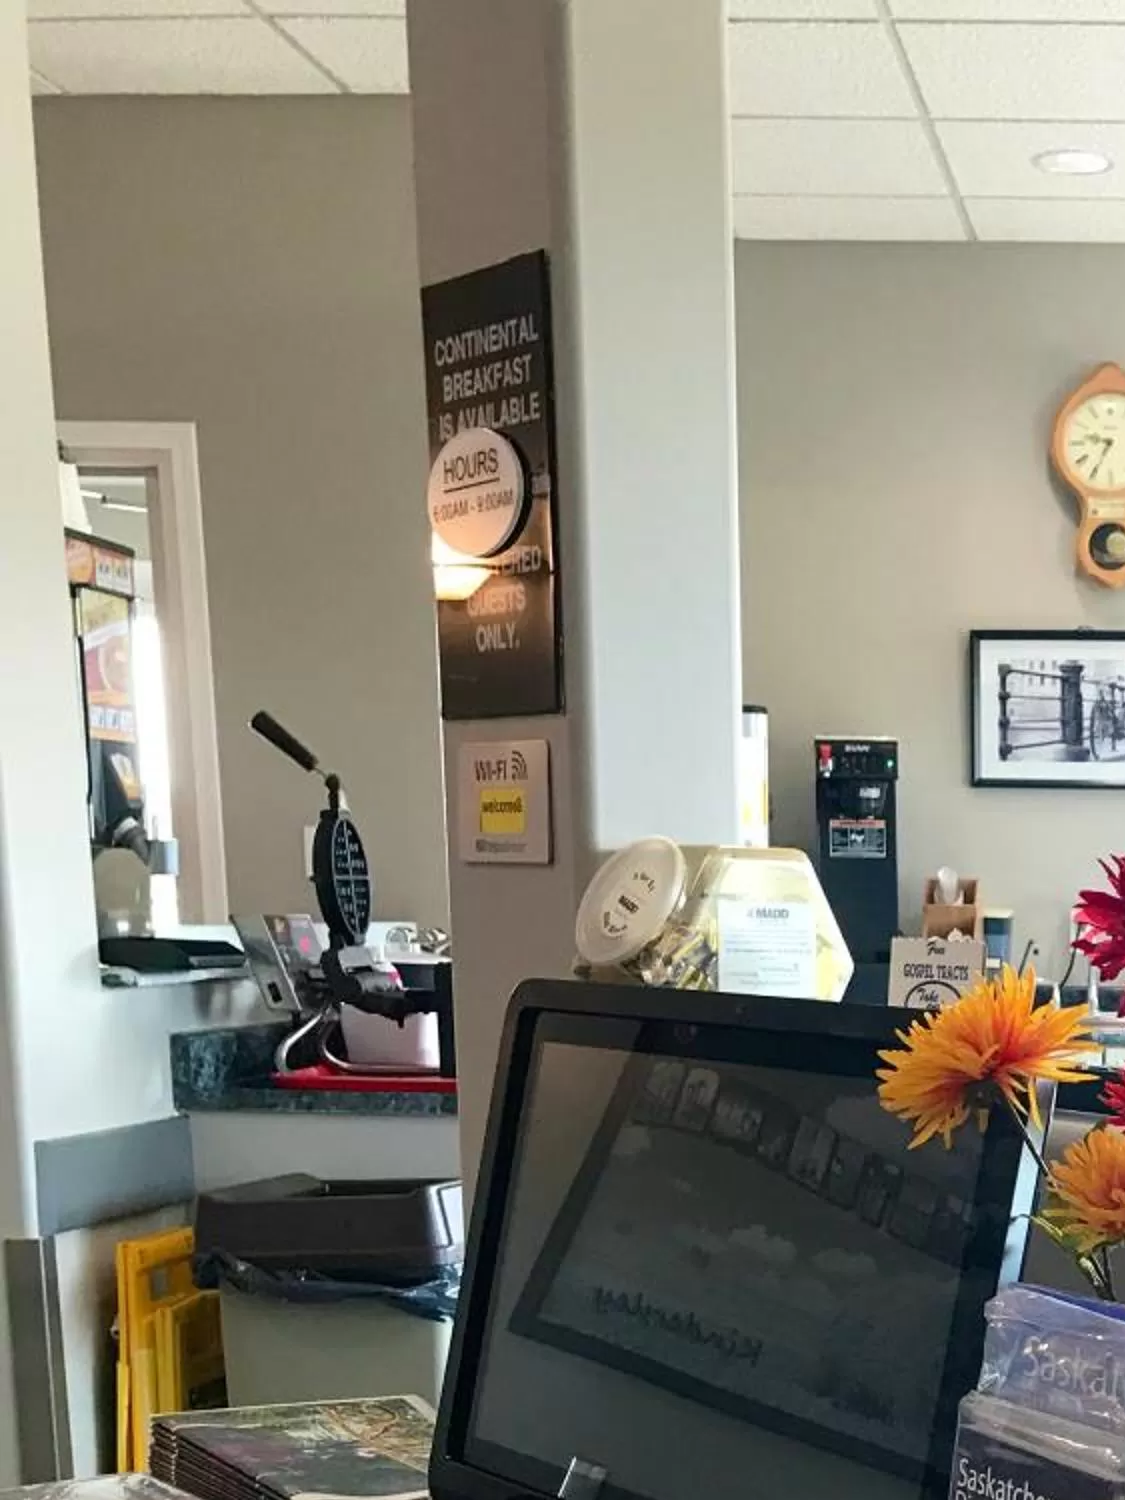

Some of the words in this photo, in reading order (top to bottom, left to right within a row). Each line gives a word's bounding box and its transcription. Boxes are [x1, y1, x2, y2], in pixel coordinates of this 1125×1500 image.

[435, 313, 539, 367] CONTINENTAL
[443, 353, 532, 403] BREAKFAST
[440, 412, 454, 440] IS
[457, 391, 541, 430] AVAILABLE
[443, 447, 499, 484] HOURS
[475, 620, 520, 652] ONLY.
[903, 962, 936, 979] GOSPEL
[937, 964, 969, 981] TRACTS
